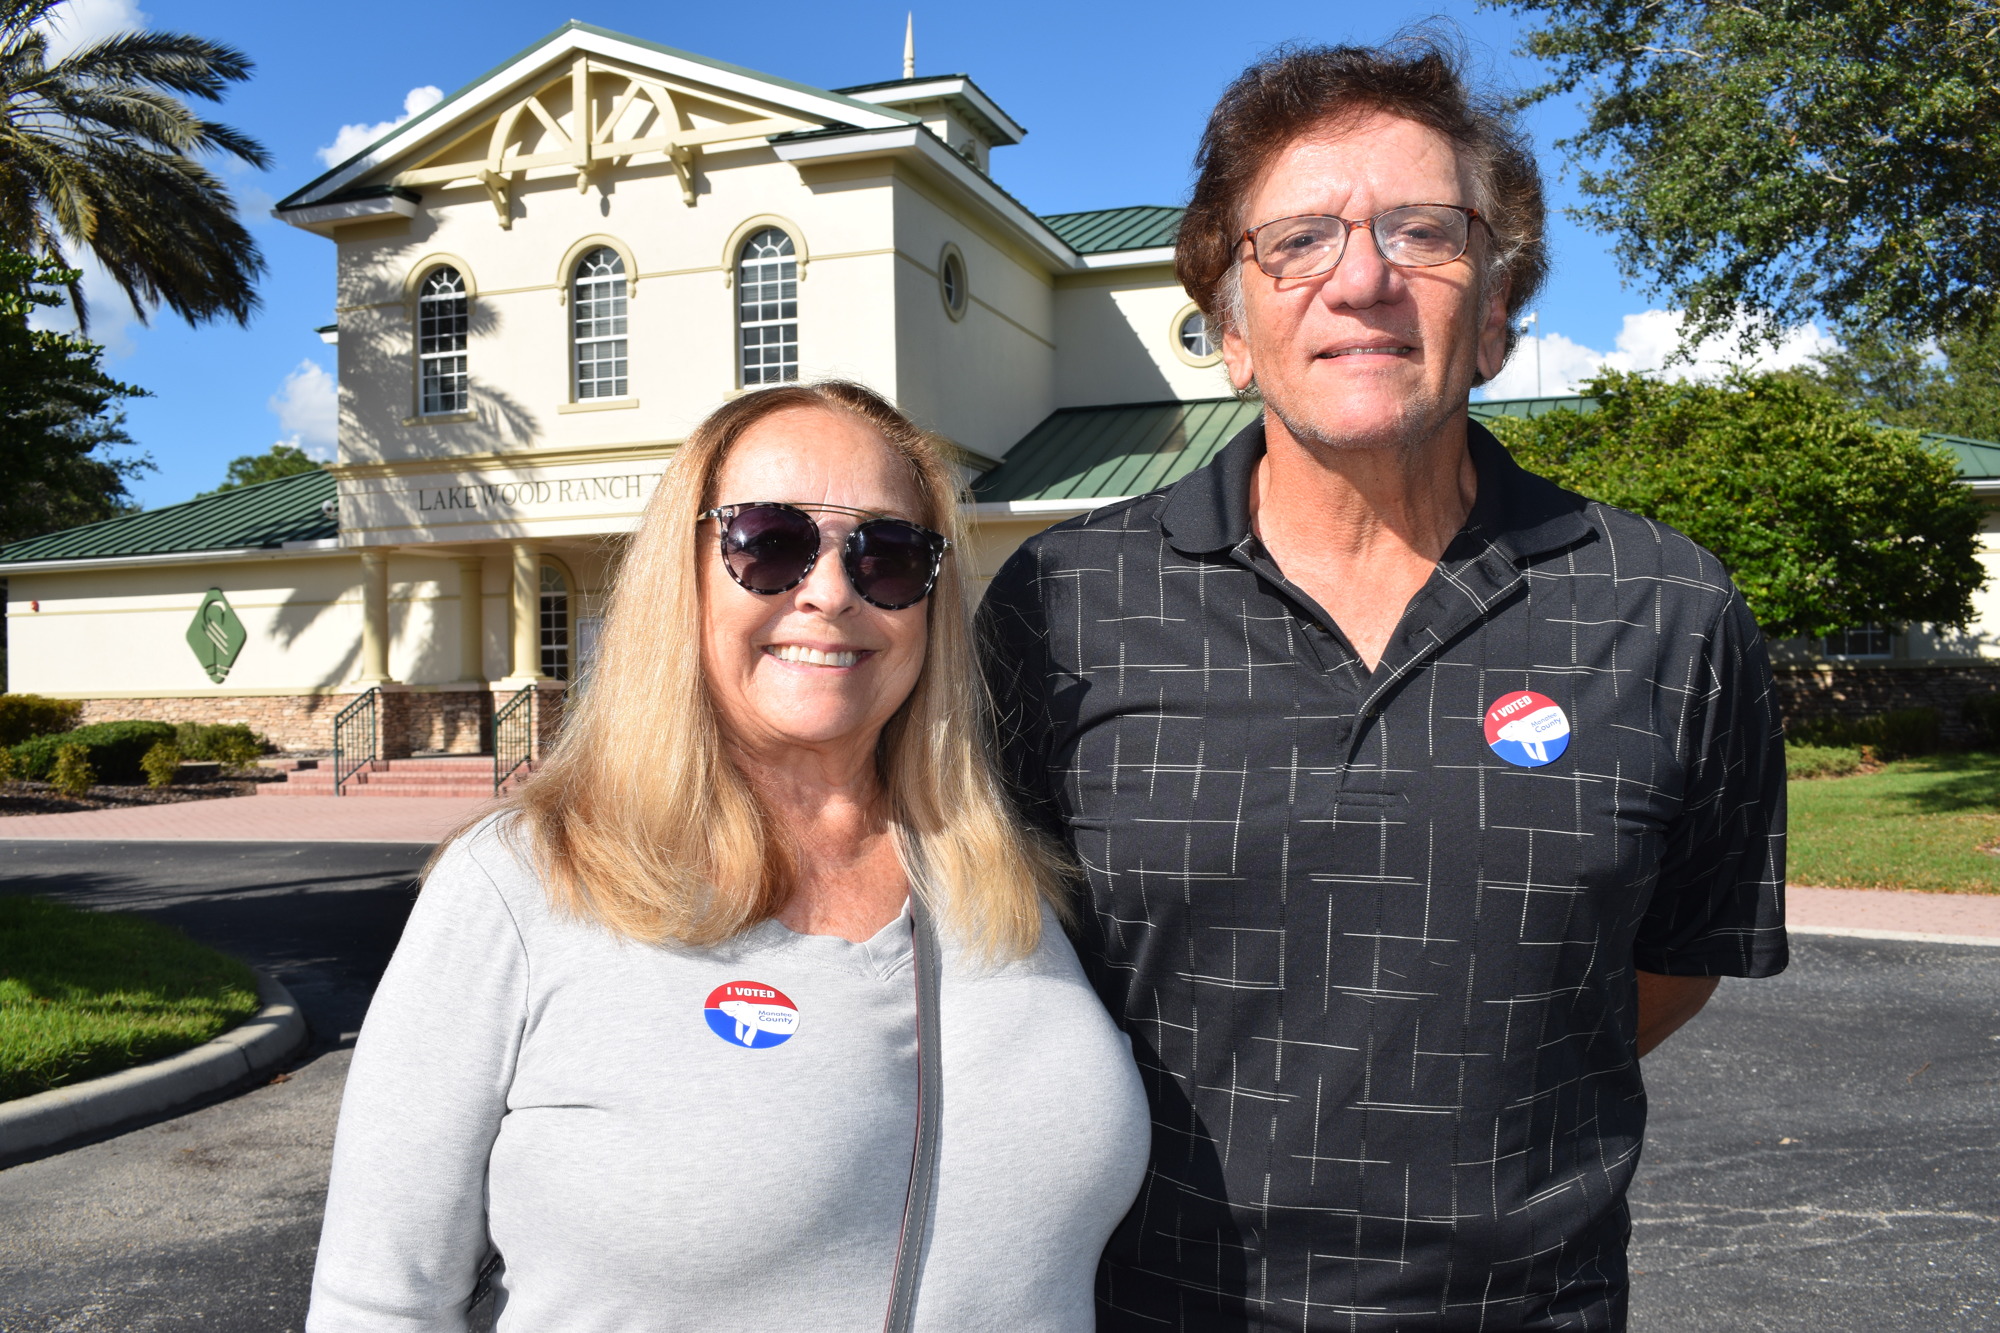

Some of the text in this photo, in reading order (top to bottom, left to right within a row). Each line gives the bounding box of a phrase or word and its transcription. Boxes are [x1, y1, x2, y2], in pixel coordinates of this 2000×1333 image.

[419, 475, 641, 511] LAKEWOOD RANCH
[1491, 695, 1533, 721] I VOTED
[1531, 713, 1557, 727] Manatee
[1535, 718, 1561, 732] County
[727, 987, 775, 998] I VOTED
[758, 1010, 793, 1018] Manatee
[758, 1015, 793, 1024] County
